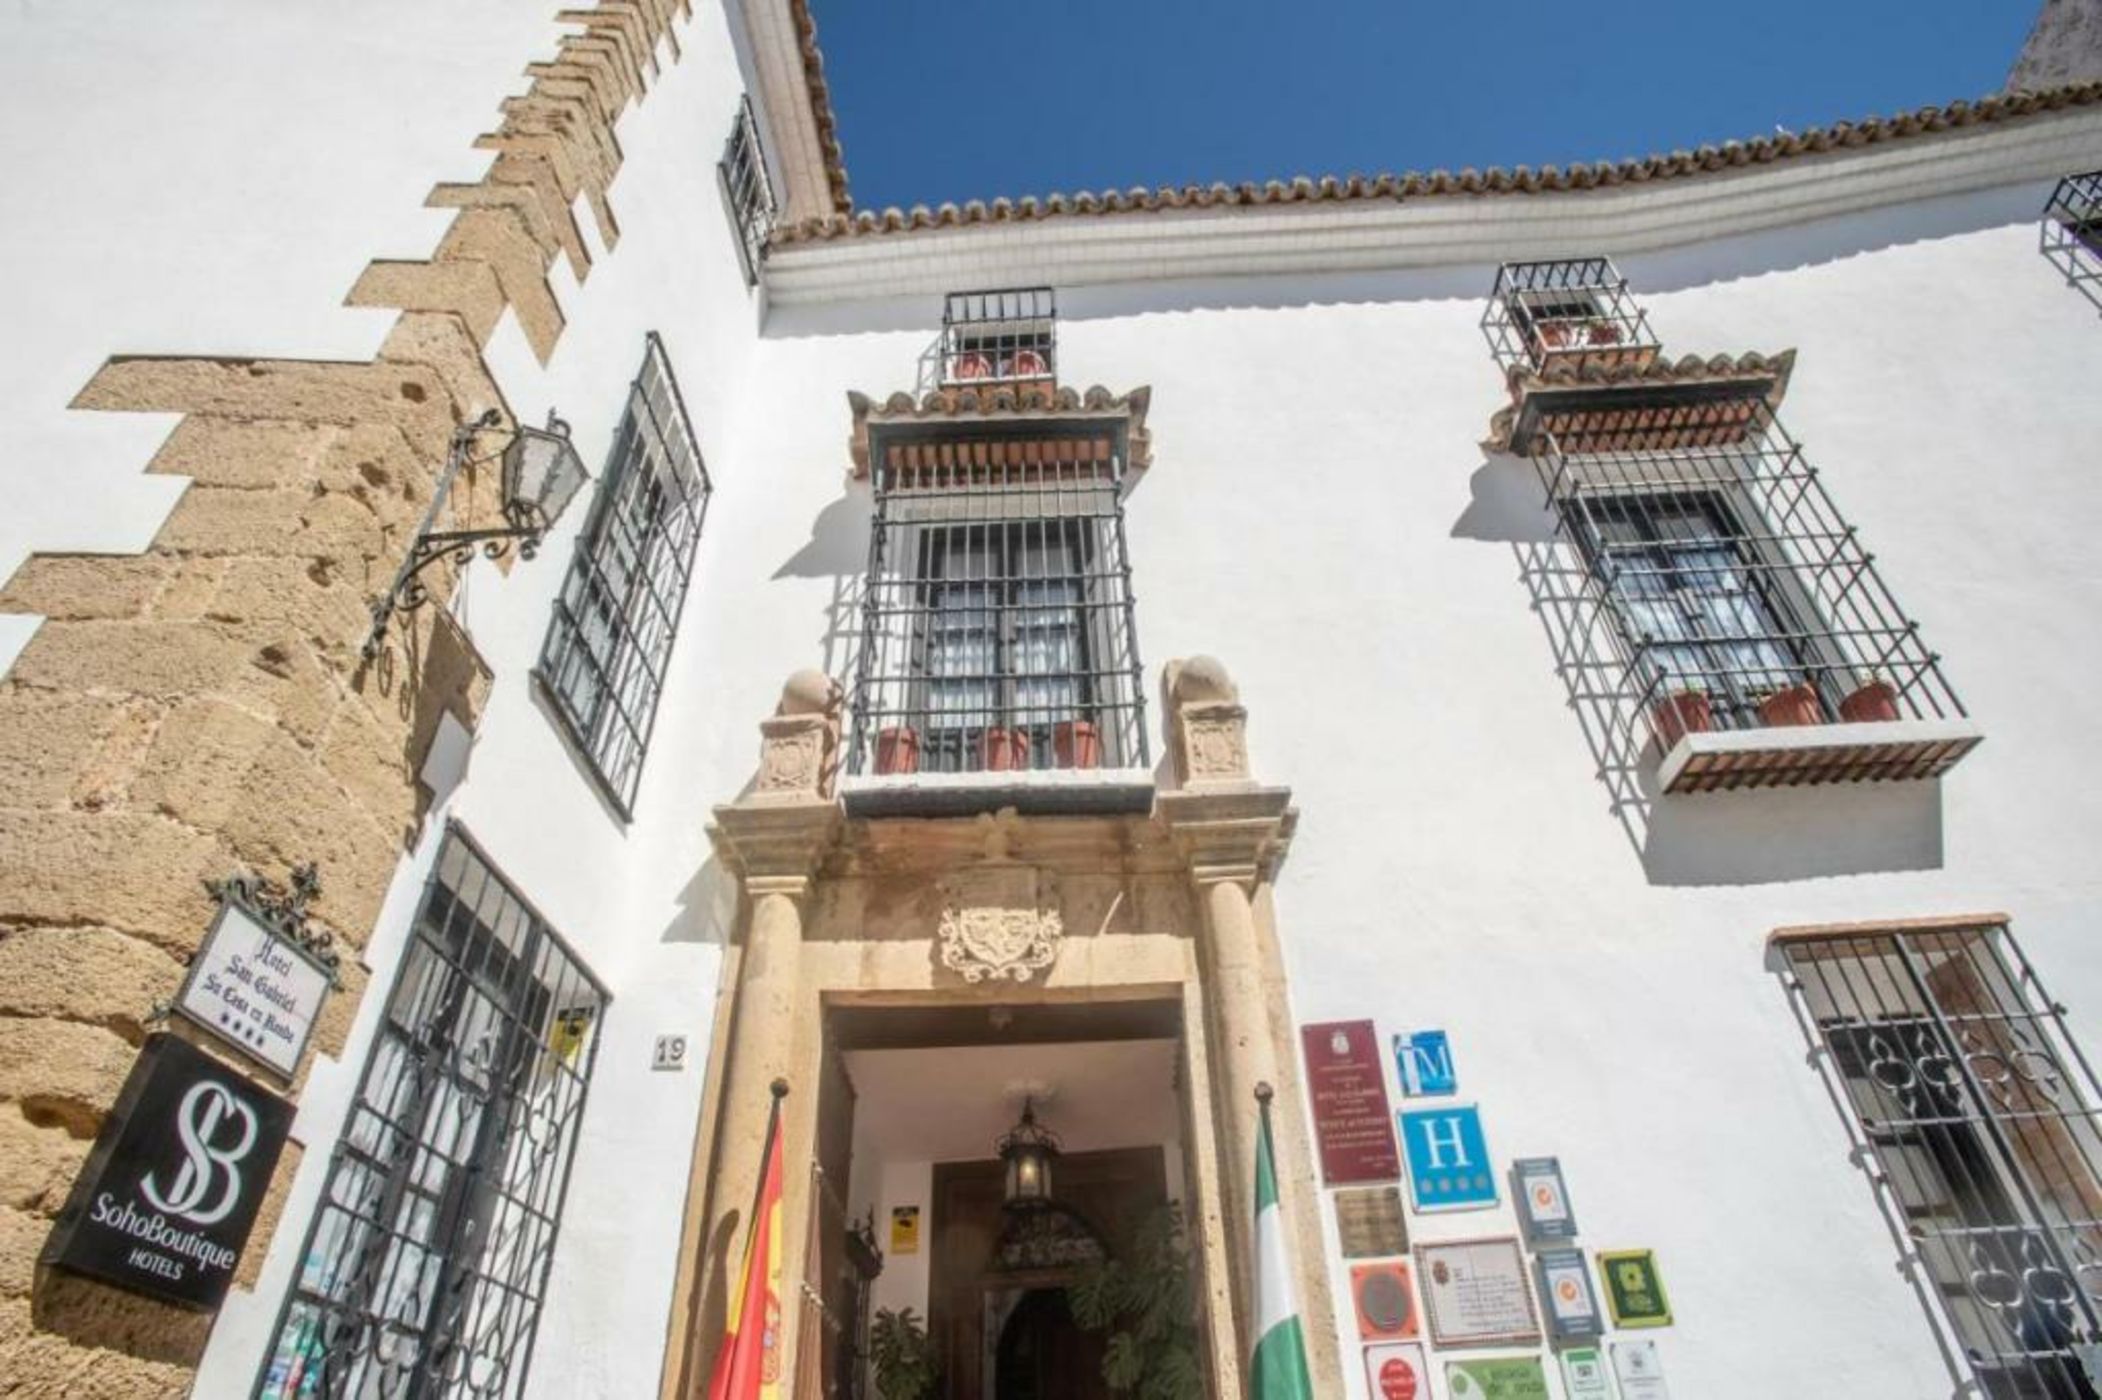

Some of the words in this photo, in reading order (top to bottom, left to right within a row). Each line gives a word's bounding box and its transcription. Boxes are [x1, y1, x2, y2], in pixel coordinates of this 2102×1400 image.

[225, 954, 252, 985] San
[255, 936, 293, 977] Hotel
[657, 1037, 686, 1063] 19
[1420, 1116, 1473, 1169] H
[90, 1192, 236, 1271] SohoBoutique
[128, 1248, 184, 1280] HOTELS
